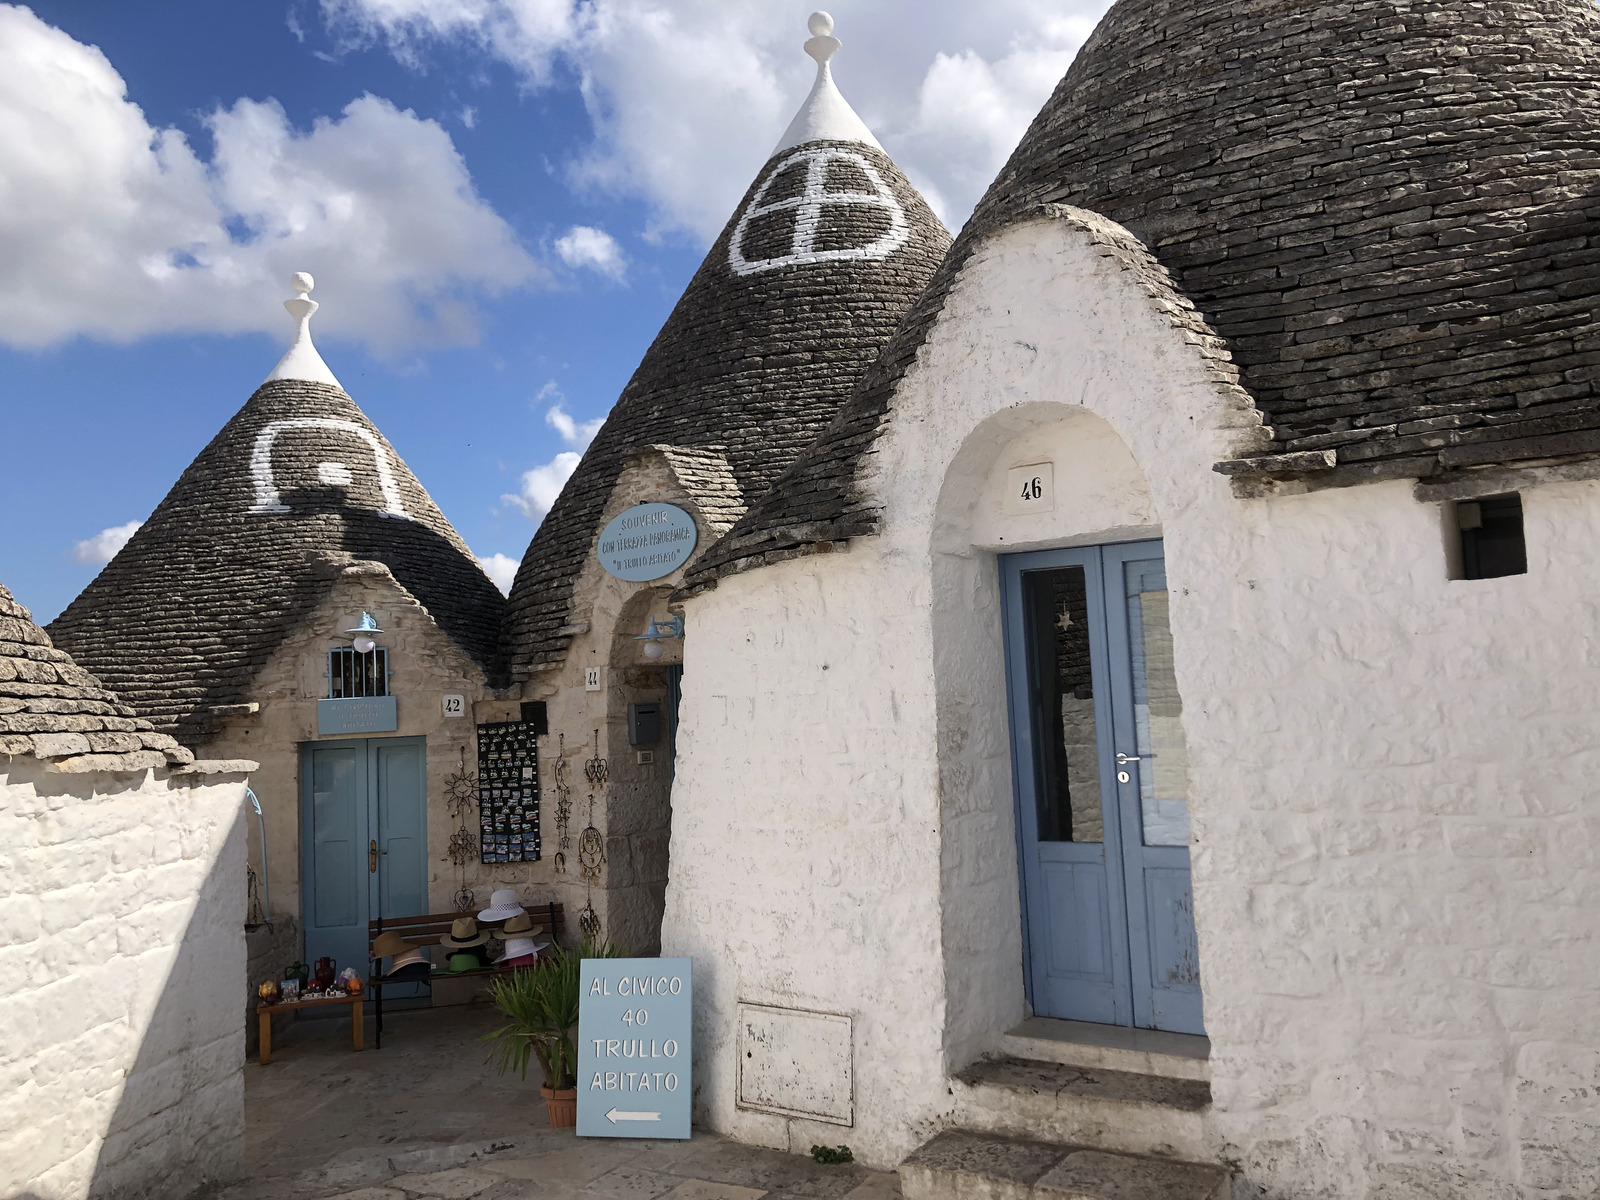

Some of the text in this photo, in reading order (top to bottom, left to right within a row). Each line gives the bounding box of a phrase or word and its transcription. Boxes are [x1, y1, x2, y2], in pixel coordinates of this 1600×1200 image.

[1020, 476, 1042, 501] 46
[621, 511, 668, 531] SOUVENIR
[602, 526, 690, 554] CON TERRAZZA PANORAMICA
[588, 671, 598, 686] 44
[445, 698, 461, 713] 42
[589, 976, 682, 997] AL CIVICO
[621, 1008, 649, 1027] 40
[591, 1039, 679, 1059] TRULLO
[589, 1072, 679, 1092] ABITATO
